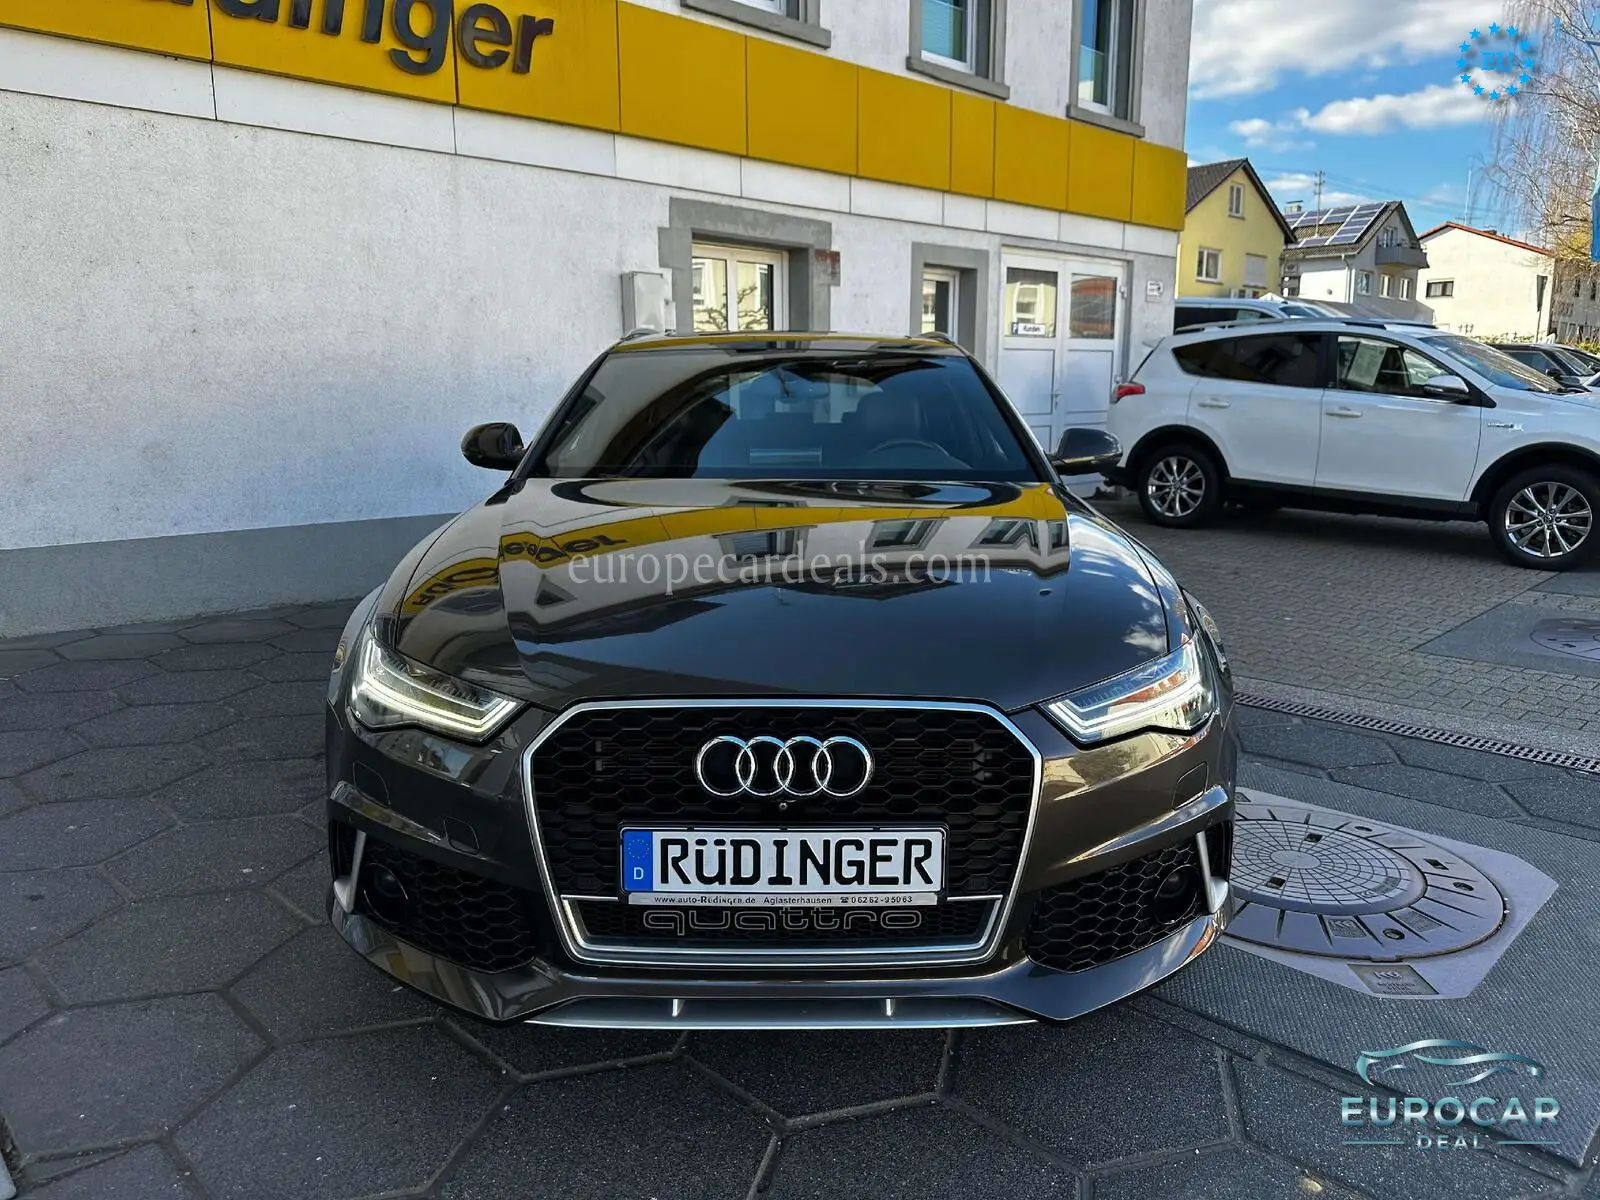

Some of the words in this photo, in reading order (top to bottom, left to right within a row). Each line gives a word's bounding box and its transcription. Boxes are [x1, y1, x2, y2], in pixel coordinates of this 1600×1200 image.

[633, 867, 644, 880] D
[763, 896, 832, 906] Aglasterhausen
[643, 906, 922, 936] quattro
